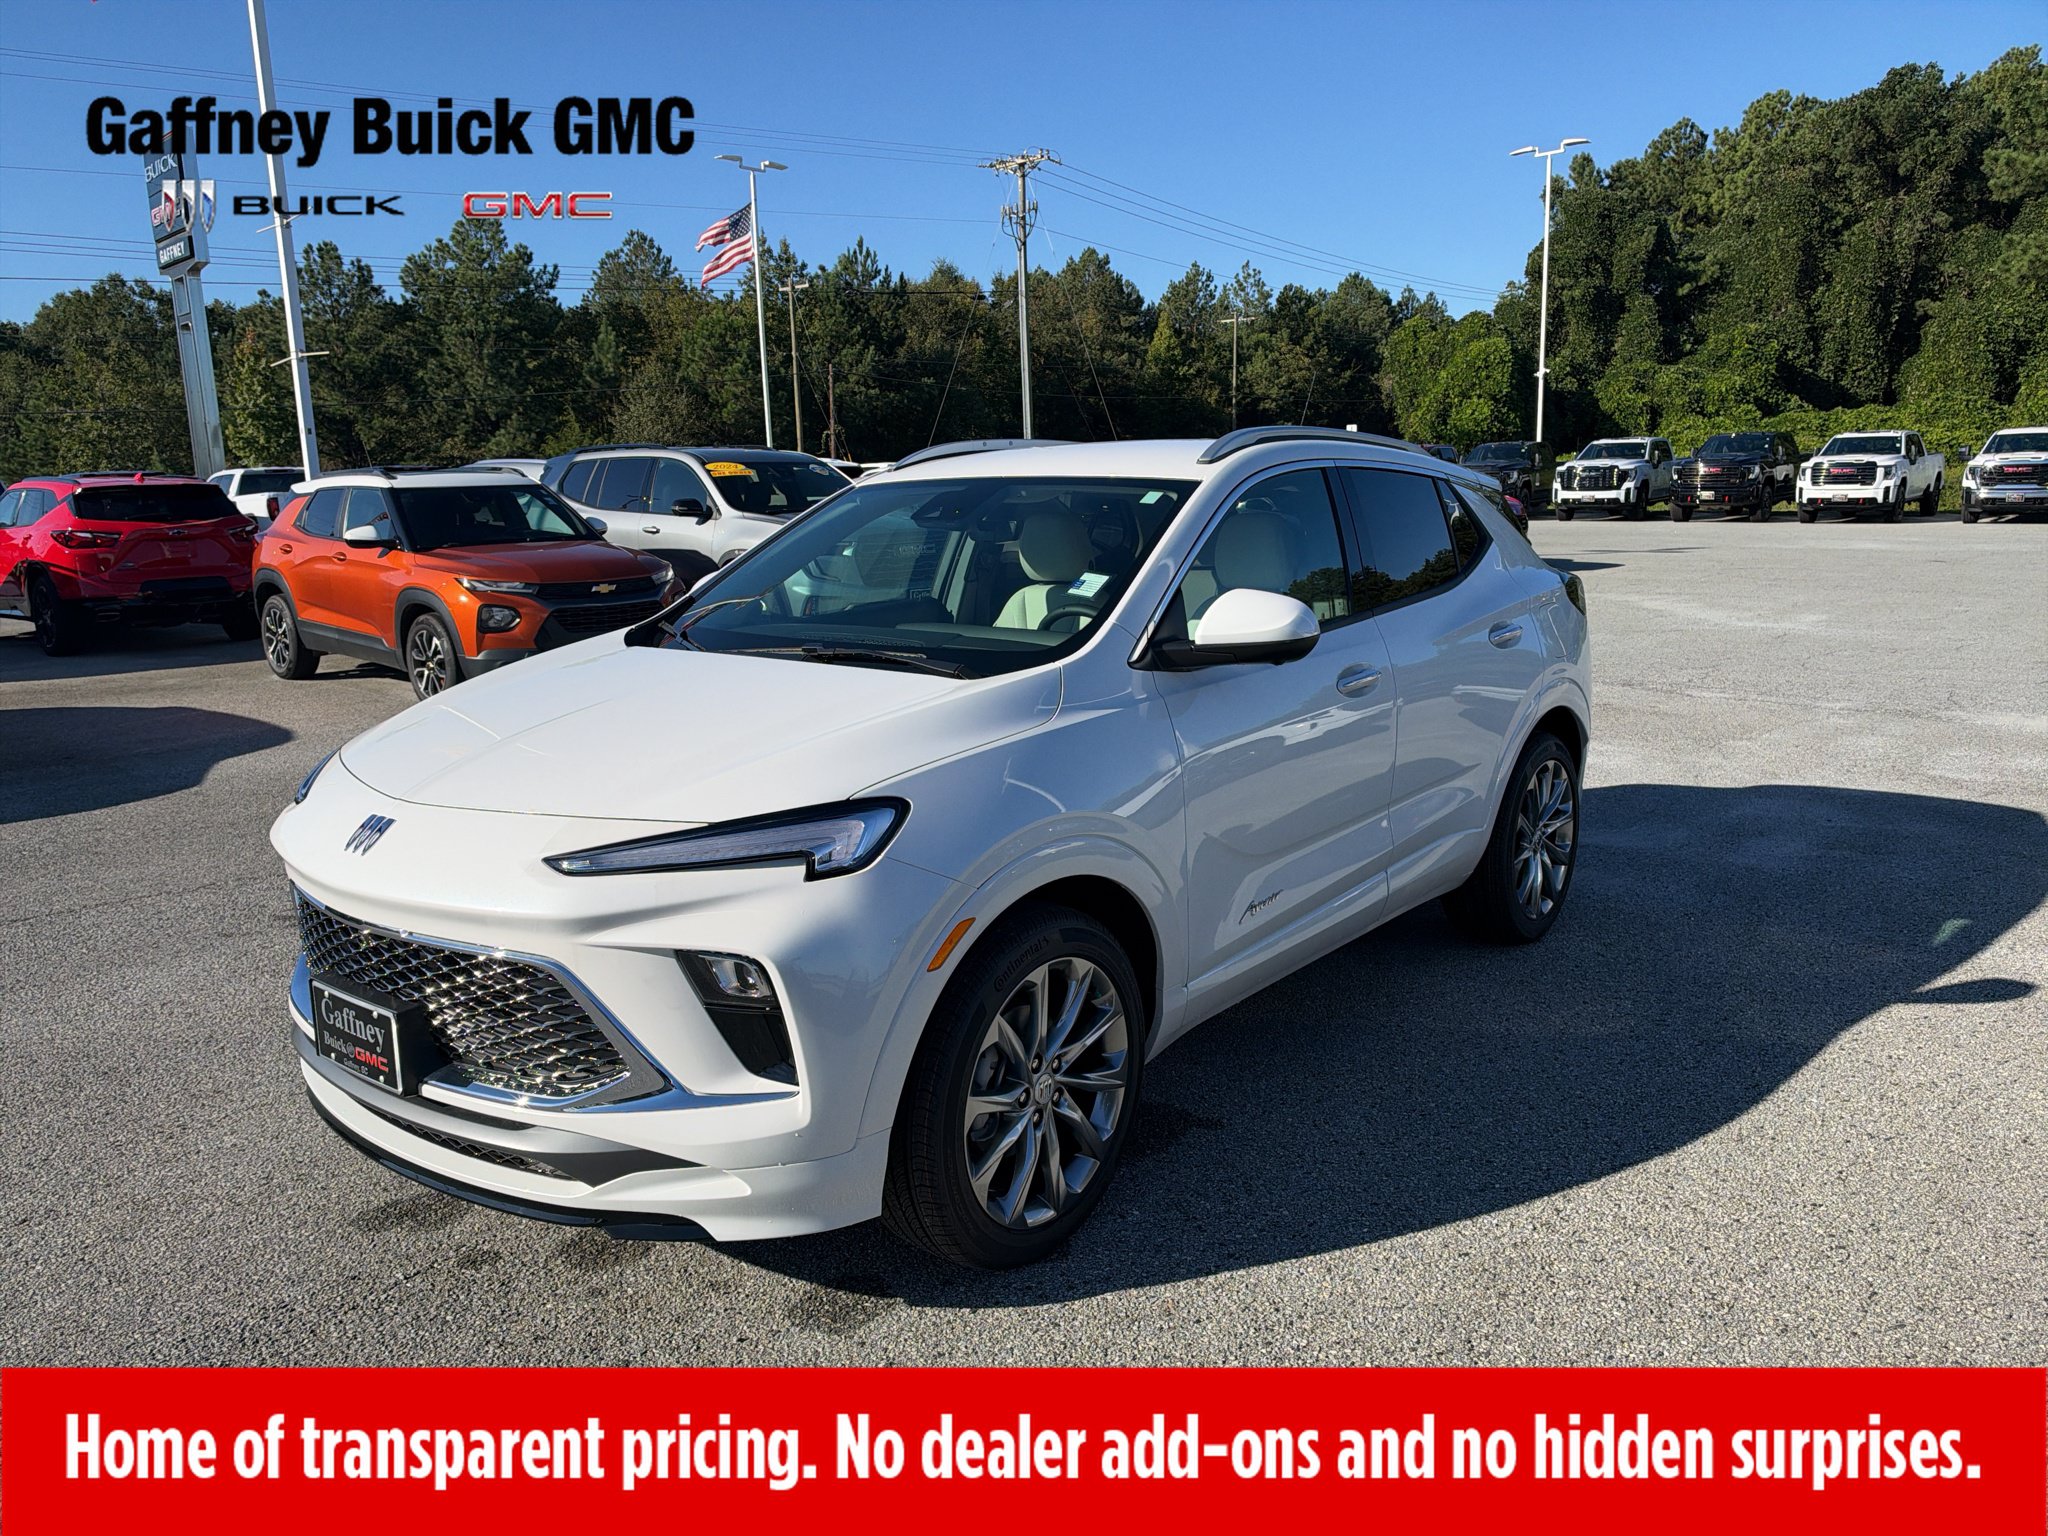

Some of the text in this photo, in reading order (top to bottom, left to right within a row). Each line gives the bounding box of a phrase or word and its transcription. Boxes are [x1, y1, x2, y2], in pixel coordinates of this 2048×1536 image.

[144, 153, 178, 183] BUICK
[159, 240, 185, 264] GAFFNEY
[321, 998, 385, 1053] Gaffney
[323, 1030, 389, 1073] Buick GMC
